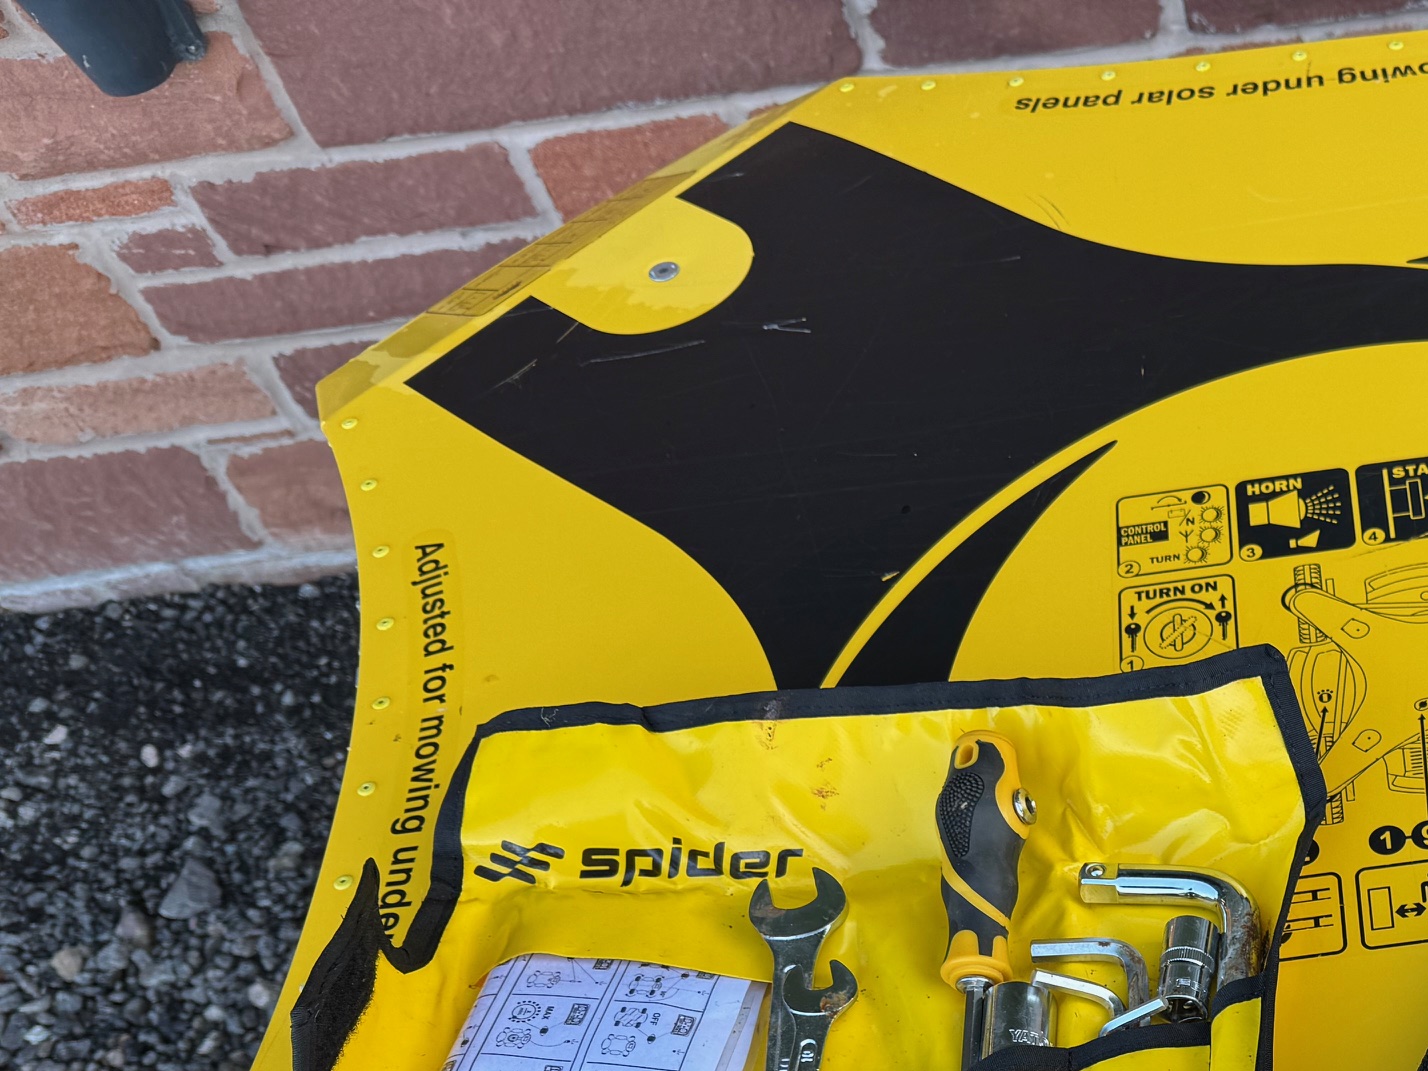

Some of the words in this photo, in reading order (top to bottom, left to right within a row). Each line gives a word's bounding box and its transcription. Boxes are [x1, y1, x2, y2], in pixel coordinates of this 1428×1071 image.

[1131, 85, 1215, 106] solar
[1226, 74, 1324, 97] under
[1015, 89, 1123, 114] panels
[1246, 477, 1303, 497] HORN
[1120, 521, 1167, 536] CONTROL
[1368, 531, 1379, 542] 4
[1121, 533, 1153, 546] PANEL
[1149, 553, 1181, 565] TURN
[1246, 548, 1256, 559] 3
[1125, 564, 1134, 575] 2
[411, 542, 455, 658] Adjusted
[1134, 585, 1186, 602] TURN
[1190, 580, 1218, 594] ON
[422, 663, 455, 704] for
[391, 714, 445, 835] mowing
[1379, 831, 1392, 850] 1
[579, 837, 803, 887] spider
[380, 845, 419, 942] unde
[541, 1005, 555, 1020] MAX
[650, 1012, 661, 1026] OFF
